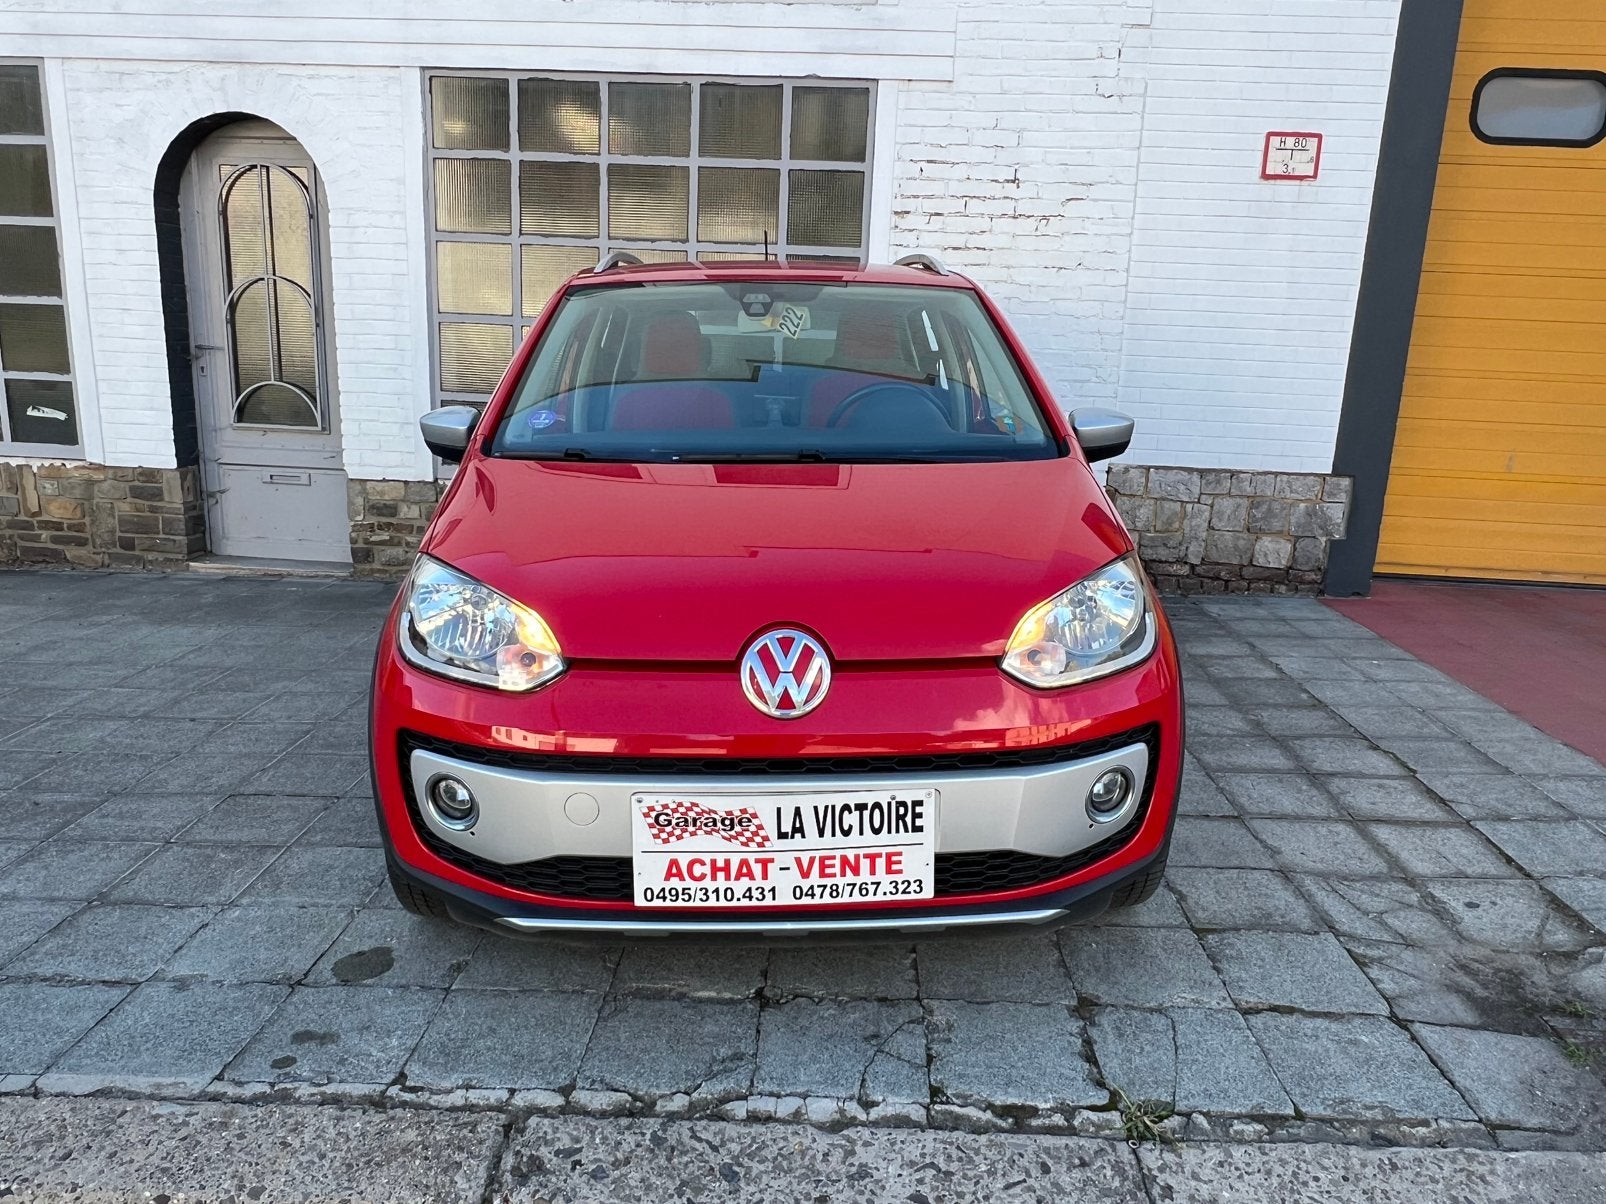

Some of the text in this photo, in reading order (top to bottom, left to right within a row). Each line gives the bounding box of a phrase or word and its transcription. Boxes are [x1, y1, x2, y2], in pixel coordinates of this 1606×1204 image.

[1279, 137, 1308, 149] H 80
[778, 306, 804, 337] 222
[653, 812, 752, 832] Garage
[776, 799, 925, 840] LA VICTOIRE
[643, 879, 924, 904] 0495/310.431 0478/767.323
